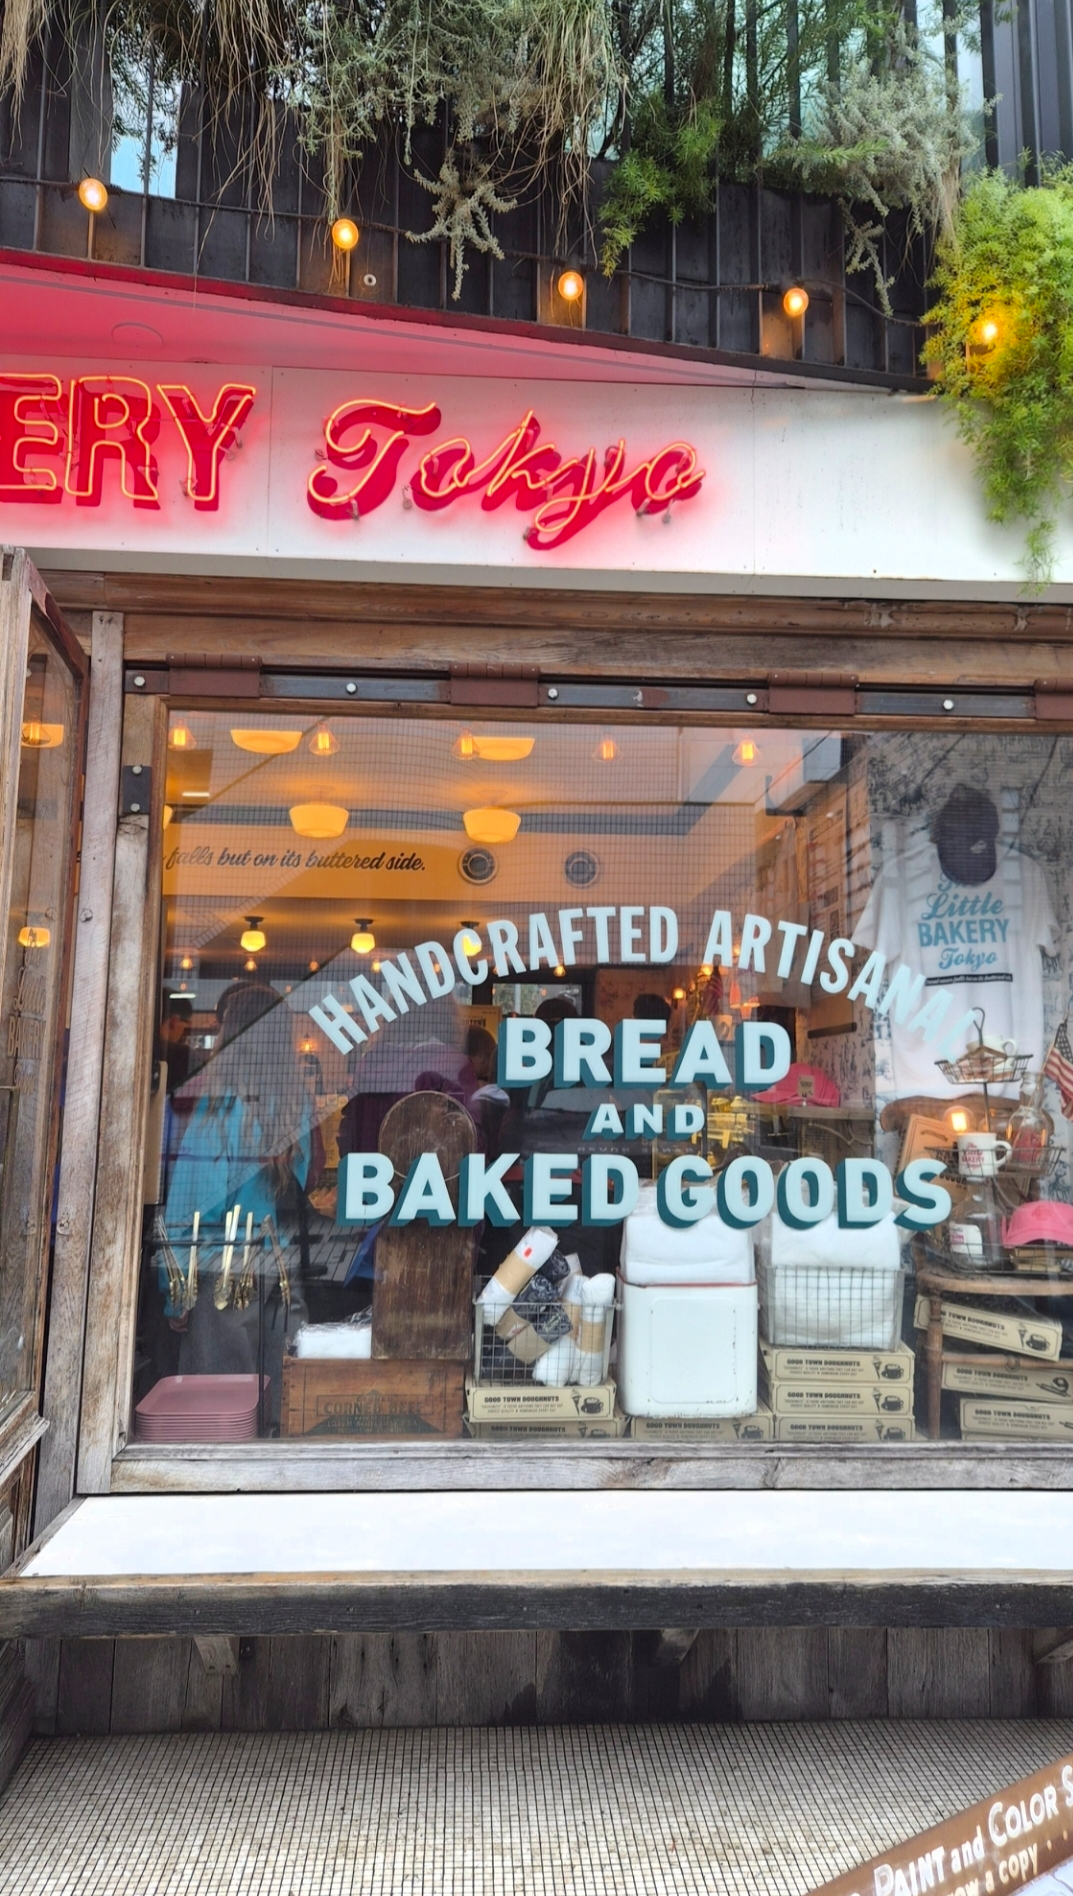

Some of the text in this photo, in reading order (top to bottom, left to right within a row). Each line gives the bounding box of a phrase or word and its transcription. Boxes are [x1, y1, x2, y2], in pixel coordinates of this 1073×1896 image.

[307, 398, 706, 551] Tokyo
[166, 846, 426, 871] falls but on its buttered side.
[921, 890, 1003, 921] Little
[918, 919, 1010, 948] BAKERY
[938, 947, 998, 972] Tokyo
[308, 906, 978, 1065] HANDCRAFTED ARTISANAL
[7, 1014, 46, 1059] BAKERY
[500, 1017, 791, 1089] BREAD
[582, 1102, 705, 1141] AND
[338, 1151, 952, 1232] BAKED GOODS
[948, 1311, 966, 1322] TOWN
[323, 1402, 424, 1414] CORNED BEEF
[873, 1845, 946, 1896] PAINT
[951, 1825, 985, 1874] and
[988, 1785, 1060, 1847] COLOR
[985, 1870, 995, 1894] a
[999, 1842, 1038, 1883] copy
